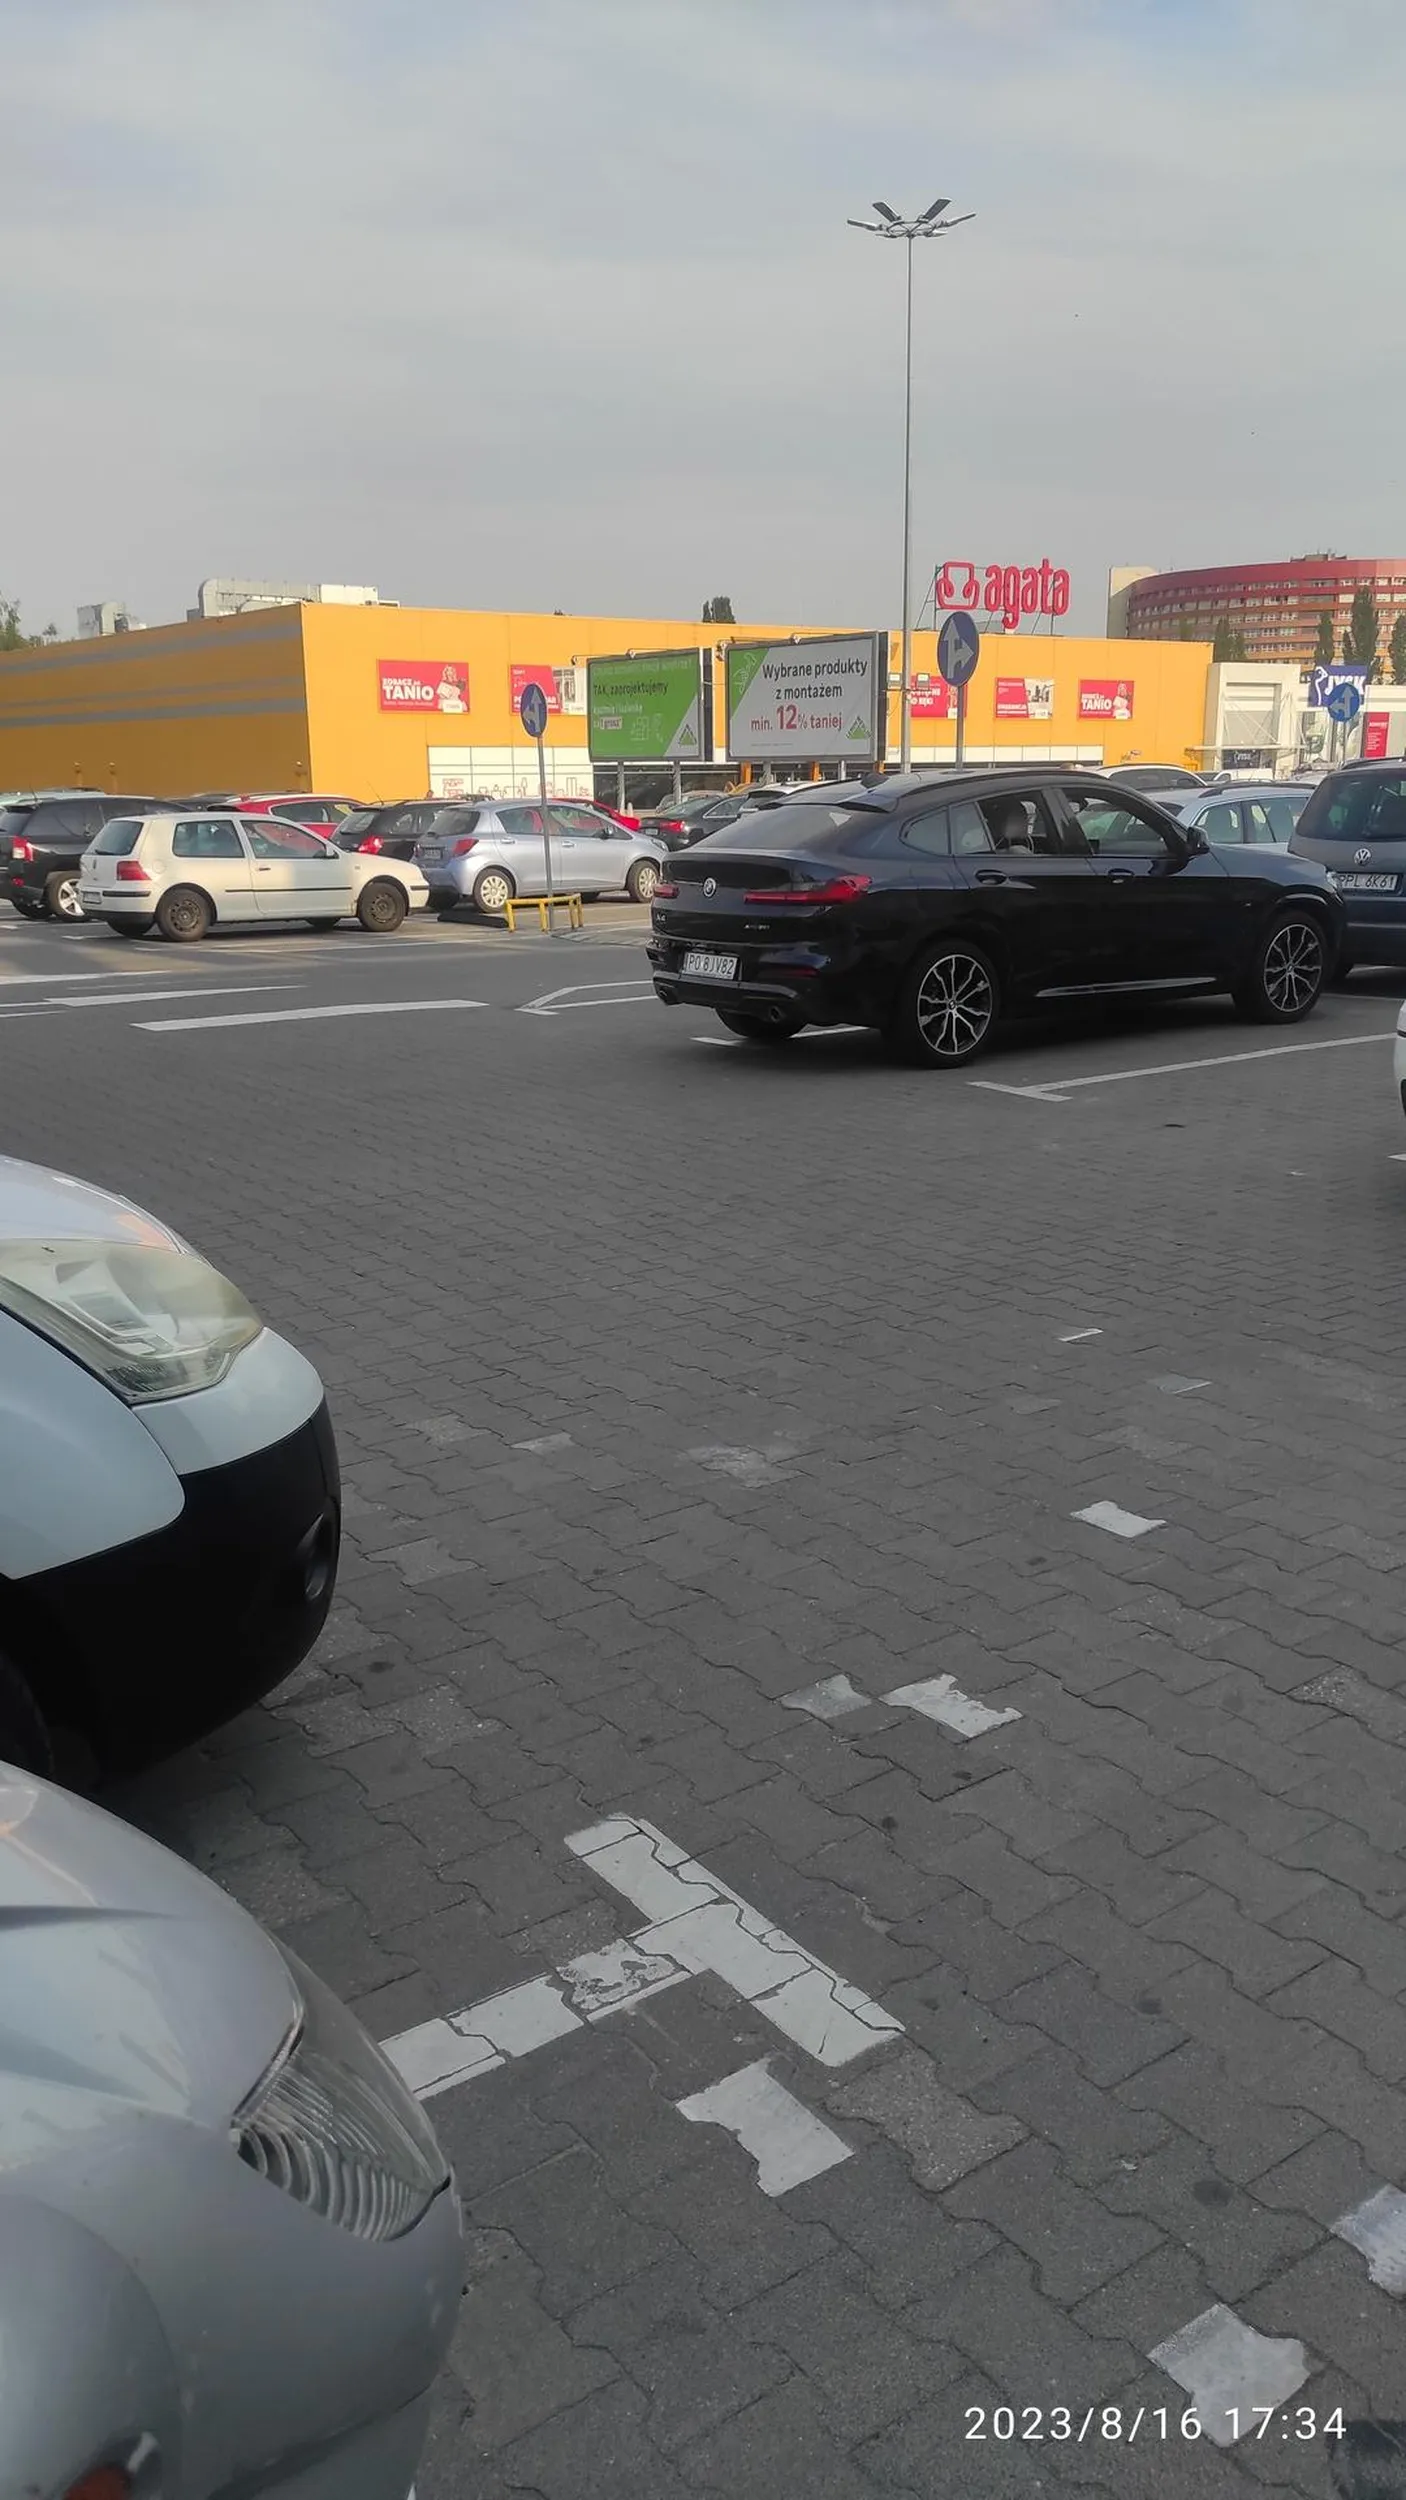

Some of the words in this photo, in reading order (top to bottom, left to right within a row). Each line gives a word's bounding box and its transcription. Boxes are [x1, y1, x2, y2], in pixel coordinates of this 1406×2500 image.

[985, 556, 1072, 629] agata
[763, 664, 812, 681] Wybrane
[815, 658, 867, 678] produkty
[382, 685, 435, 701] TANIO
[775, 688, 782, 699] z
[784, 683, 842, 699] montażem
[1082, 698, 1112, 711] TANIO
[751, 716, 773, 731] min.
[811, 712, 842, 732] taniej
